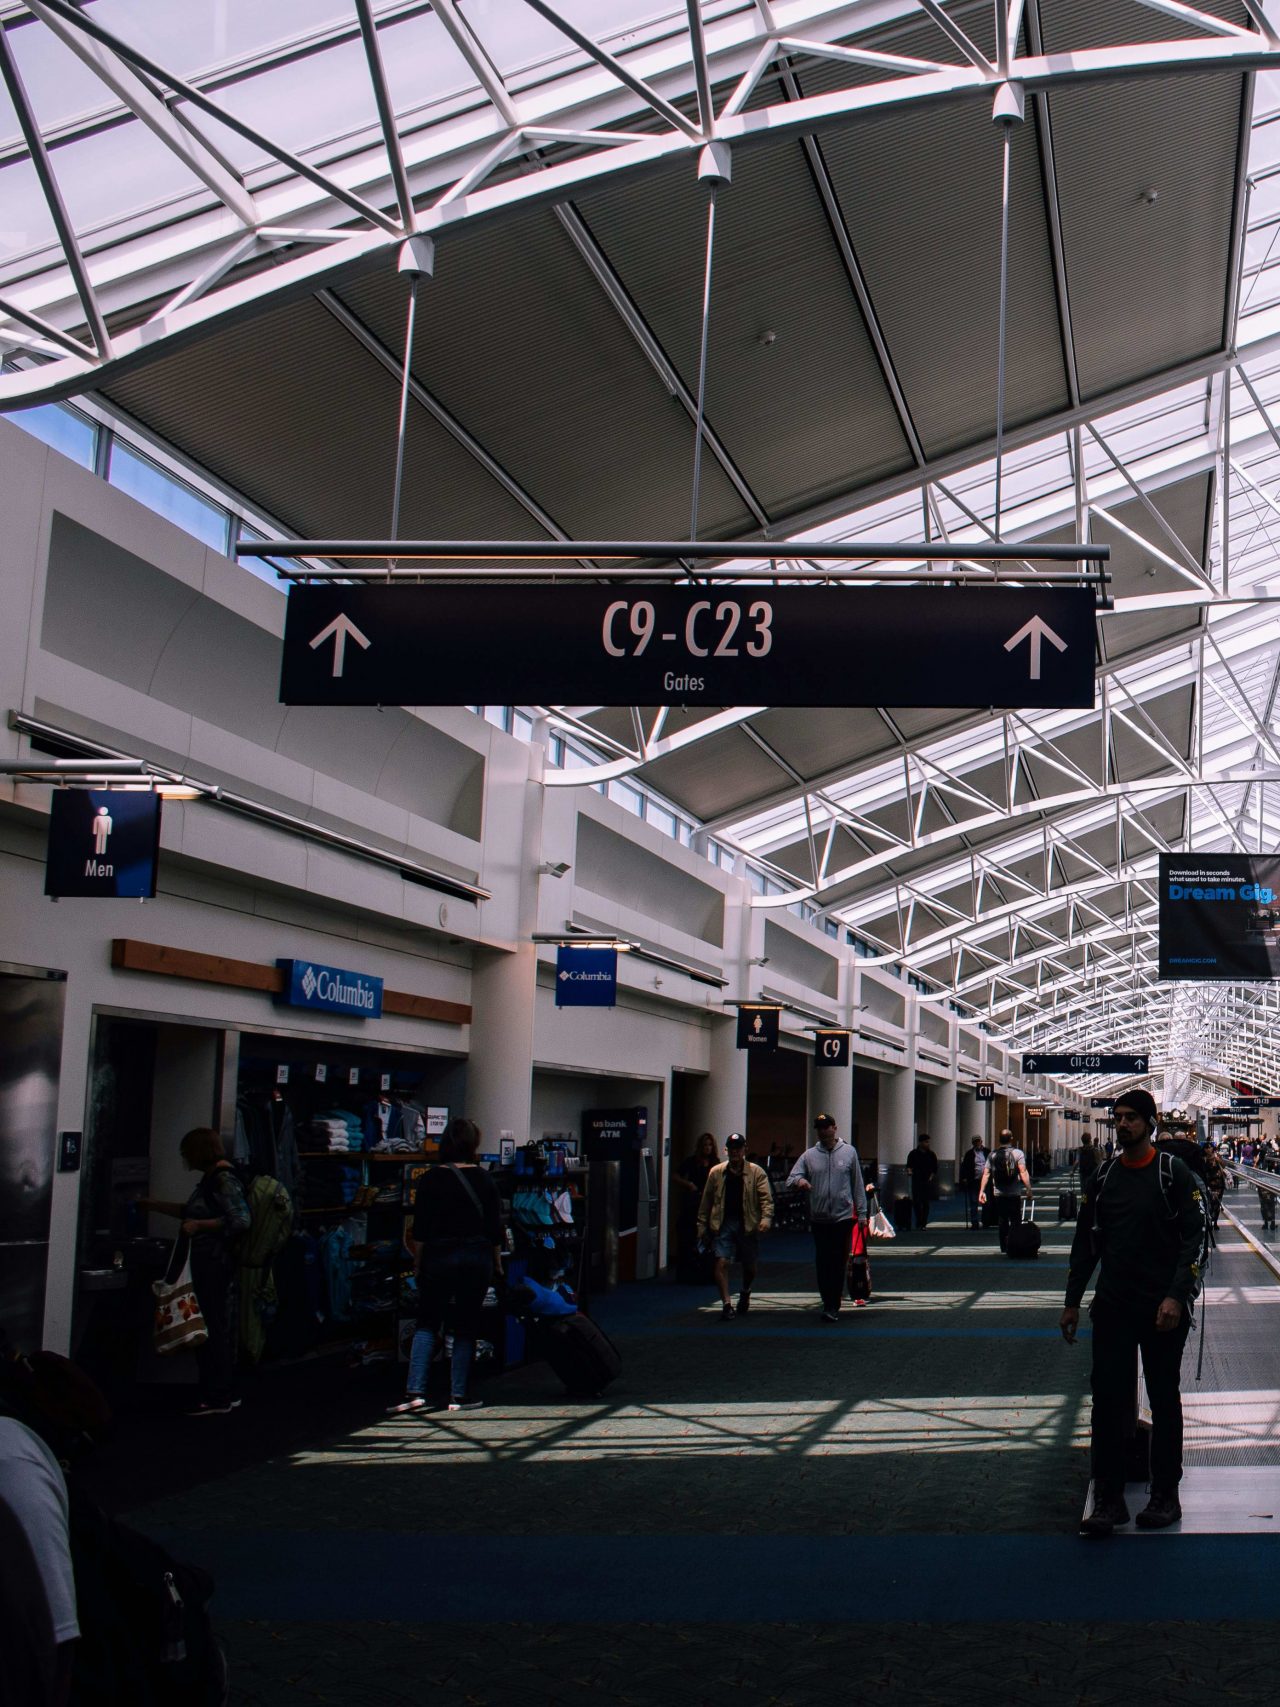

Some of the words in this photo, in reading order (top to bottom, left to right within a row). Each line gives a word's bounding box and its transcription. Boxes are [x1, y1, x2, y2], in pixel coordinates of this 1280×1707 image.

[602, 600, 773, 657] C9-C23
[664, 672, 705, 691] Gates
[85, 859, 114, 877] Men
[1169, 884, 1236, 900] Dream
[1239, 883, 1278, 905] Gig.
[569, 971, 612, 981] Columbia
[317, 971, 375, 1009] Columbia
[823, 1039, 841, 1058] C9
[1070, 1056, 1101, 1067] C11-C23
[979, 1086, 992, 1097] C11
[600, 1130, 621, 1138] ATM
